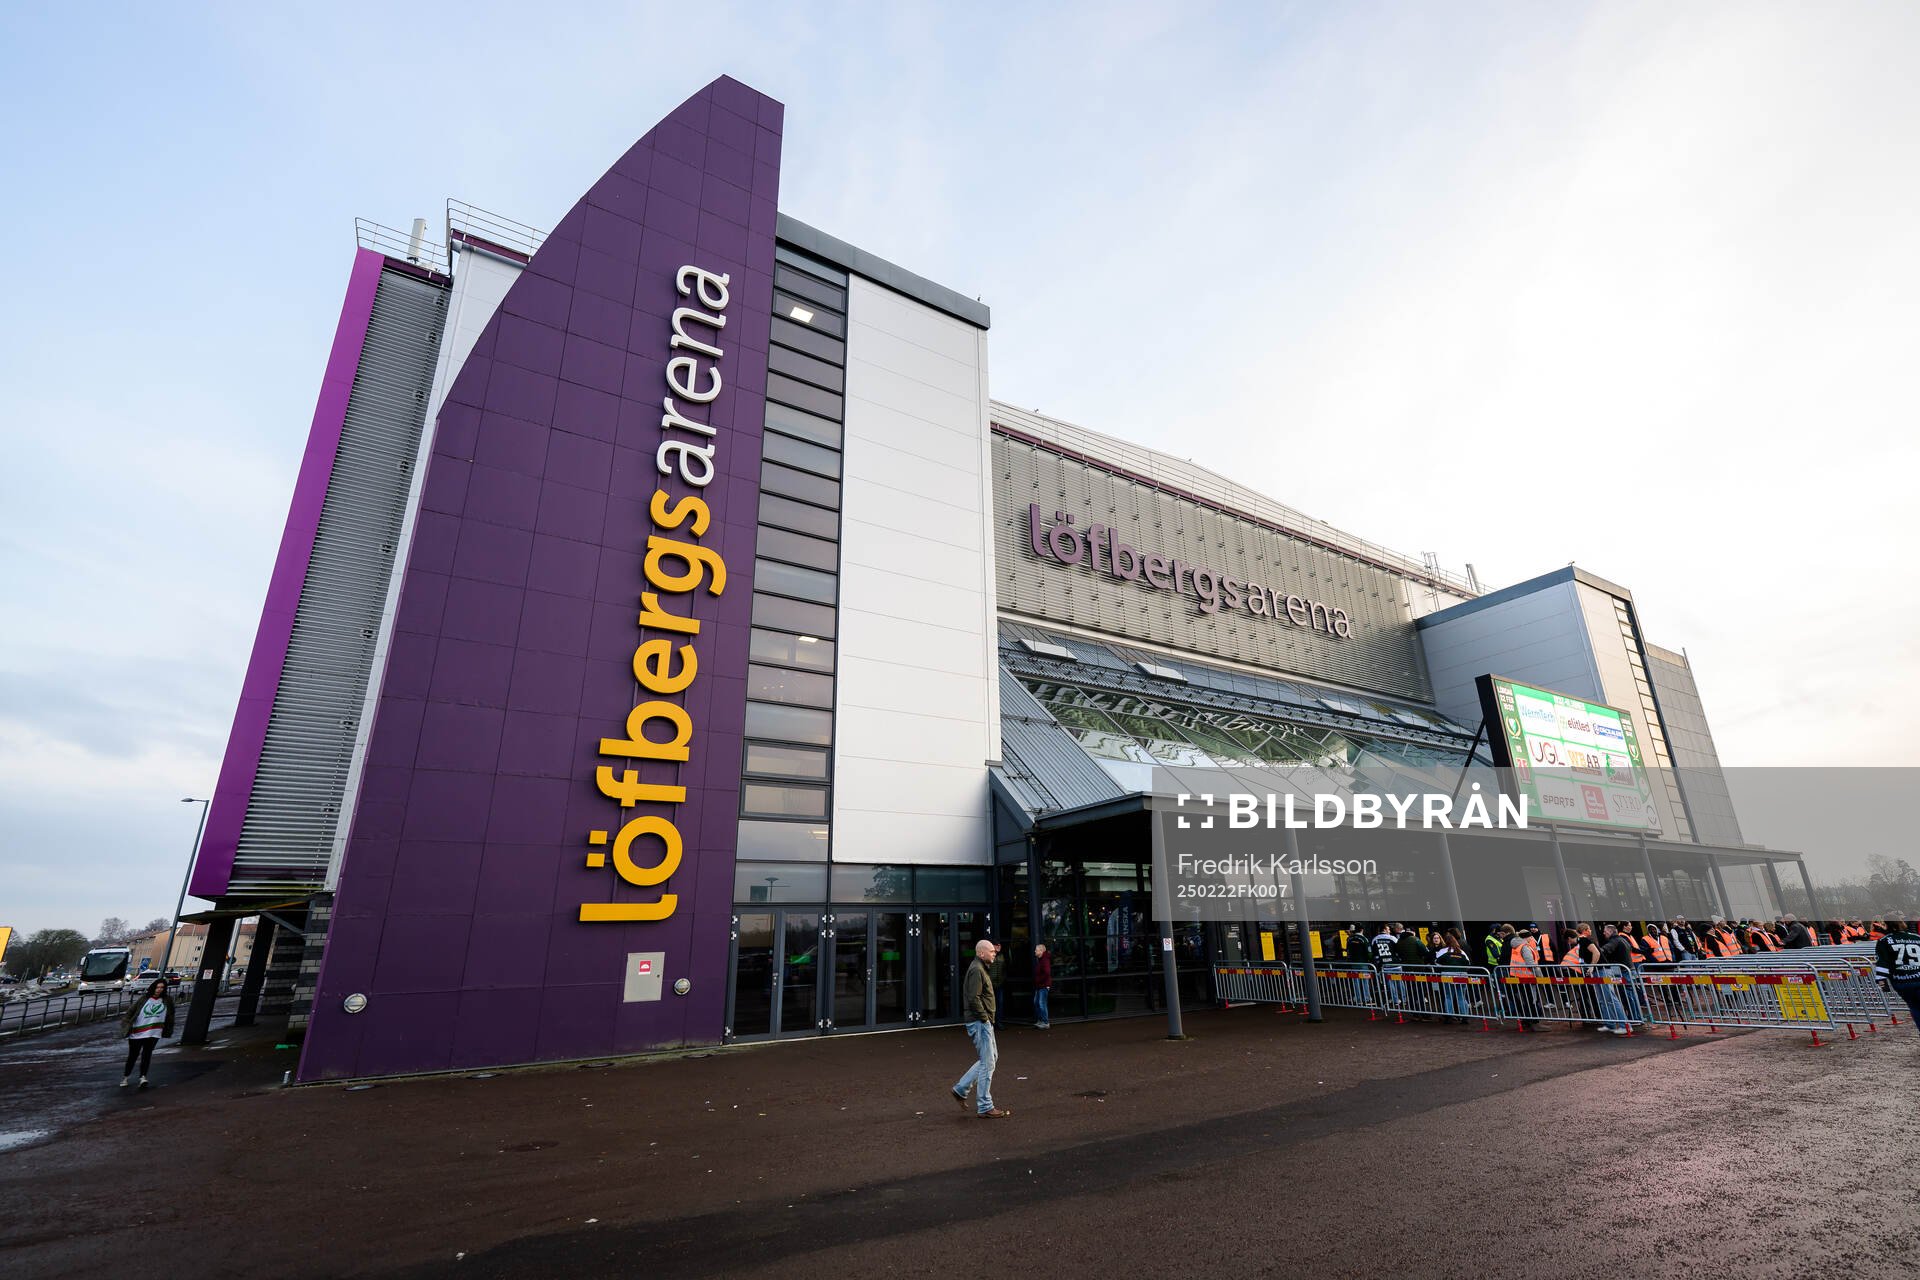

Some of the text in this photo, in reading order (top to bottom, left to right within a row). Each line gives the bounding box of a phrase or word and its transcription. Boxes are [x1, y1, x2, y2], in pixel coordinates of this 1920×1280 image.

[1029, 502, 1353, 639] löfbergsarena
[579, 264, 730, 922] löfbergsarena
[1543, 794, 1575, 809] SPORTS
[1377, 943, 1392, 956] 22
[1891, 943, 1920, 966] 79
